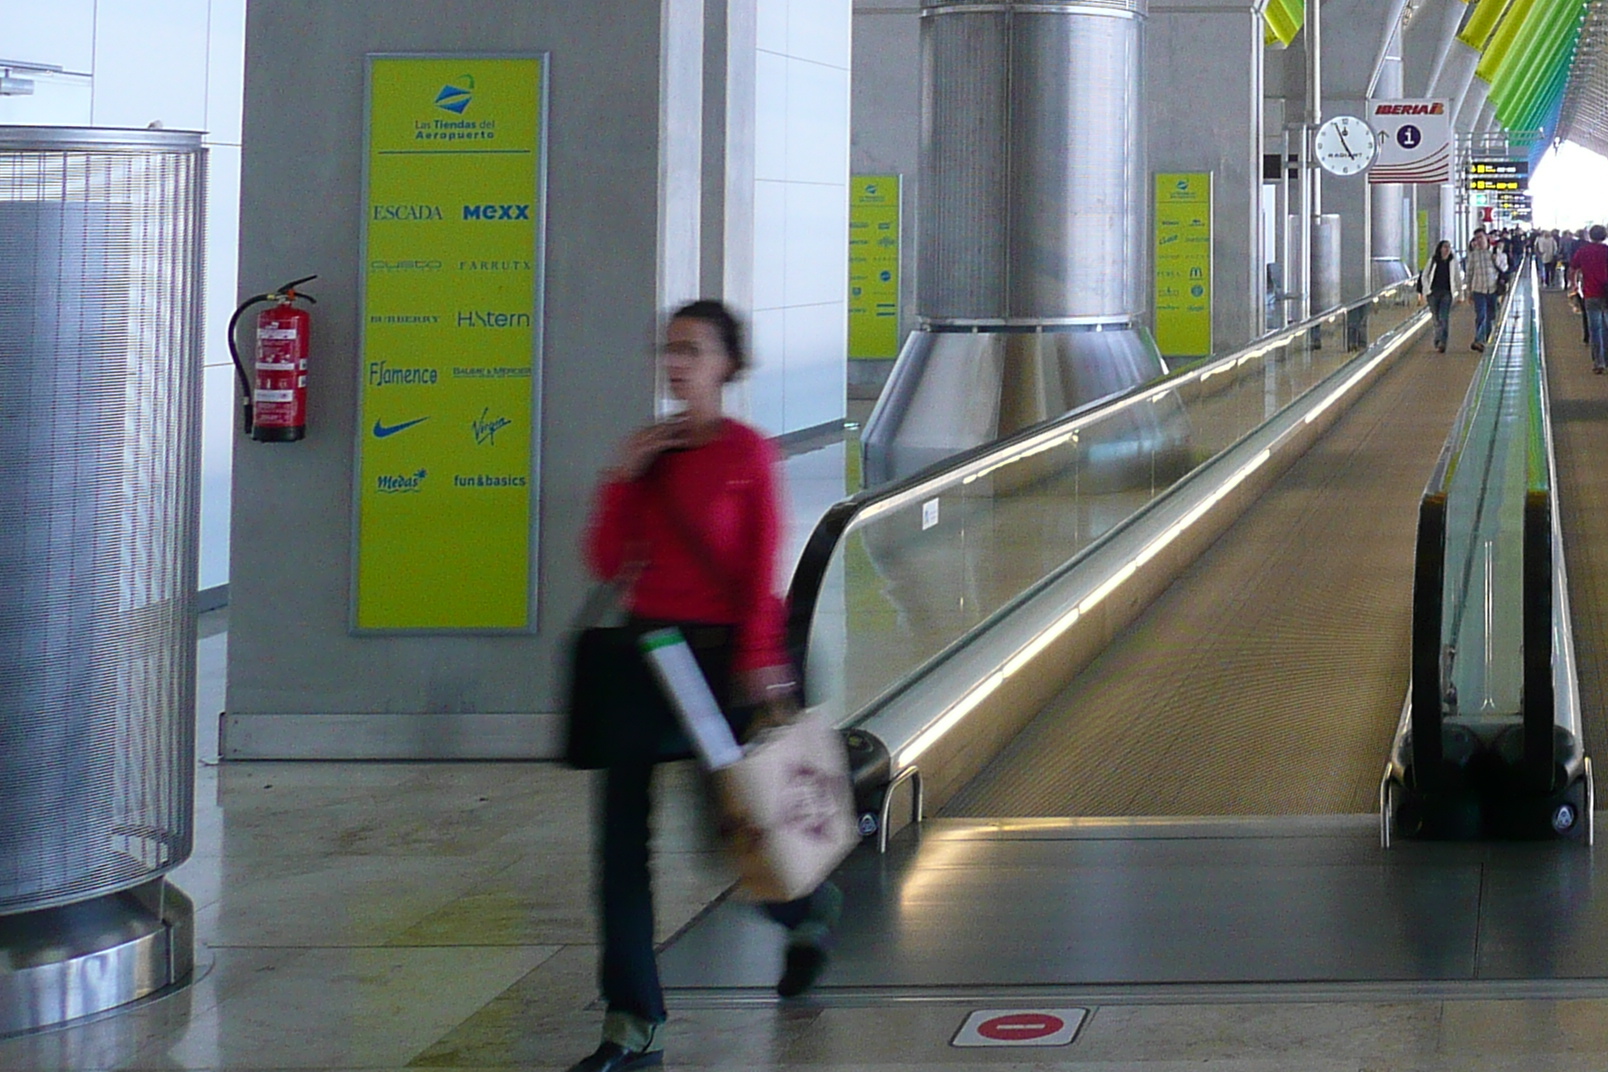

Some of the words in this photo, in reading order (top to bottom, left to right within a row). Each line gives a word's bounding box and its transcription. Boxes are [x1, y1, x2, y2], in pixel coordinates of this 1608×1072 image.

[1375, 104, 1430, 115] IBERIA
[415, 120, 431, 129] Las
[433, 119, 476, 129] Tiendas
[479, 120, 495, 129] del
[415, 130, 495, 141] Aeropuerto
[373, 205, 443, 220] ESCADA
[459, 260, 531, 270] FARRUTX
[369, 360, 438, 386] Flamenco
[472, 406, 512, 446] Virgin
[377, 475, 419, 489] Medas
[453, 474, 526, 488] fun&basics
